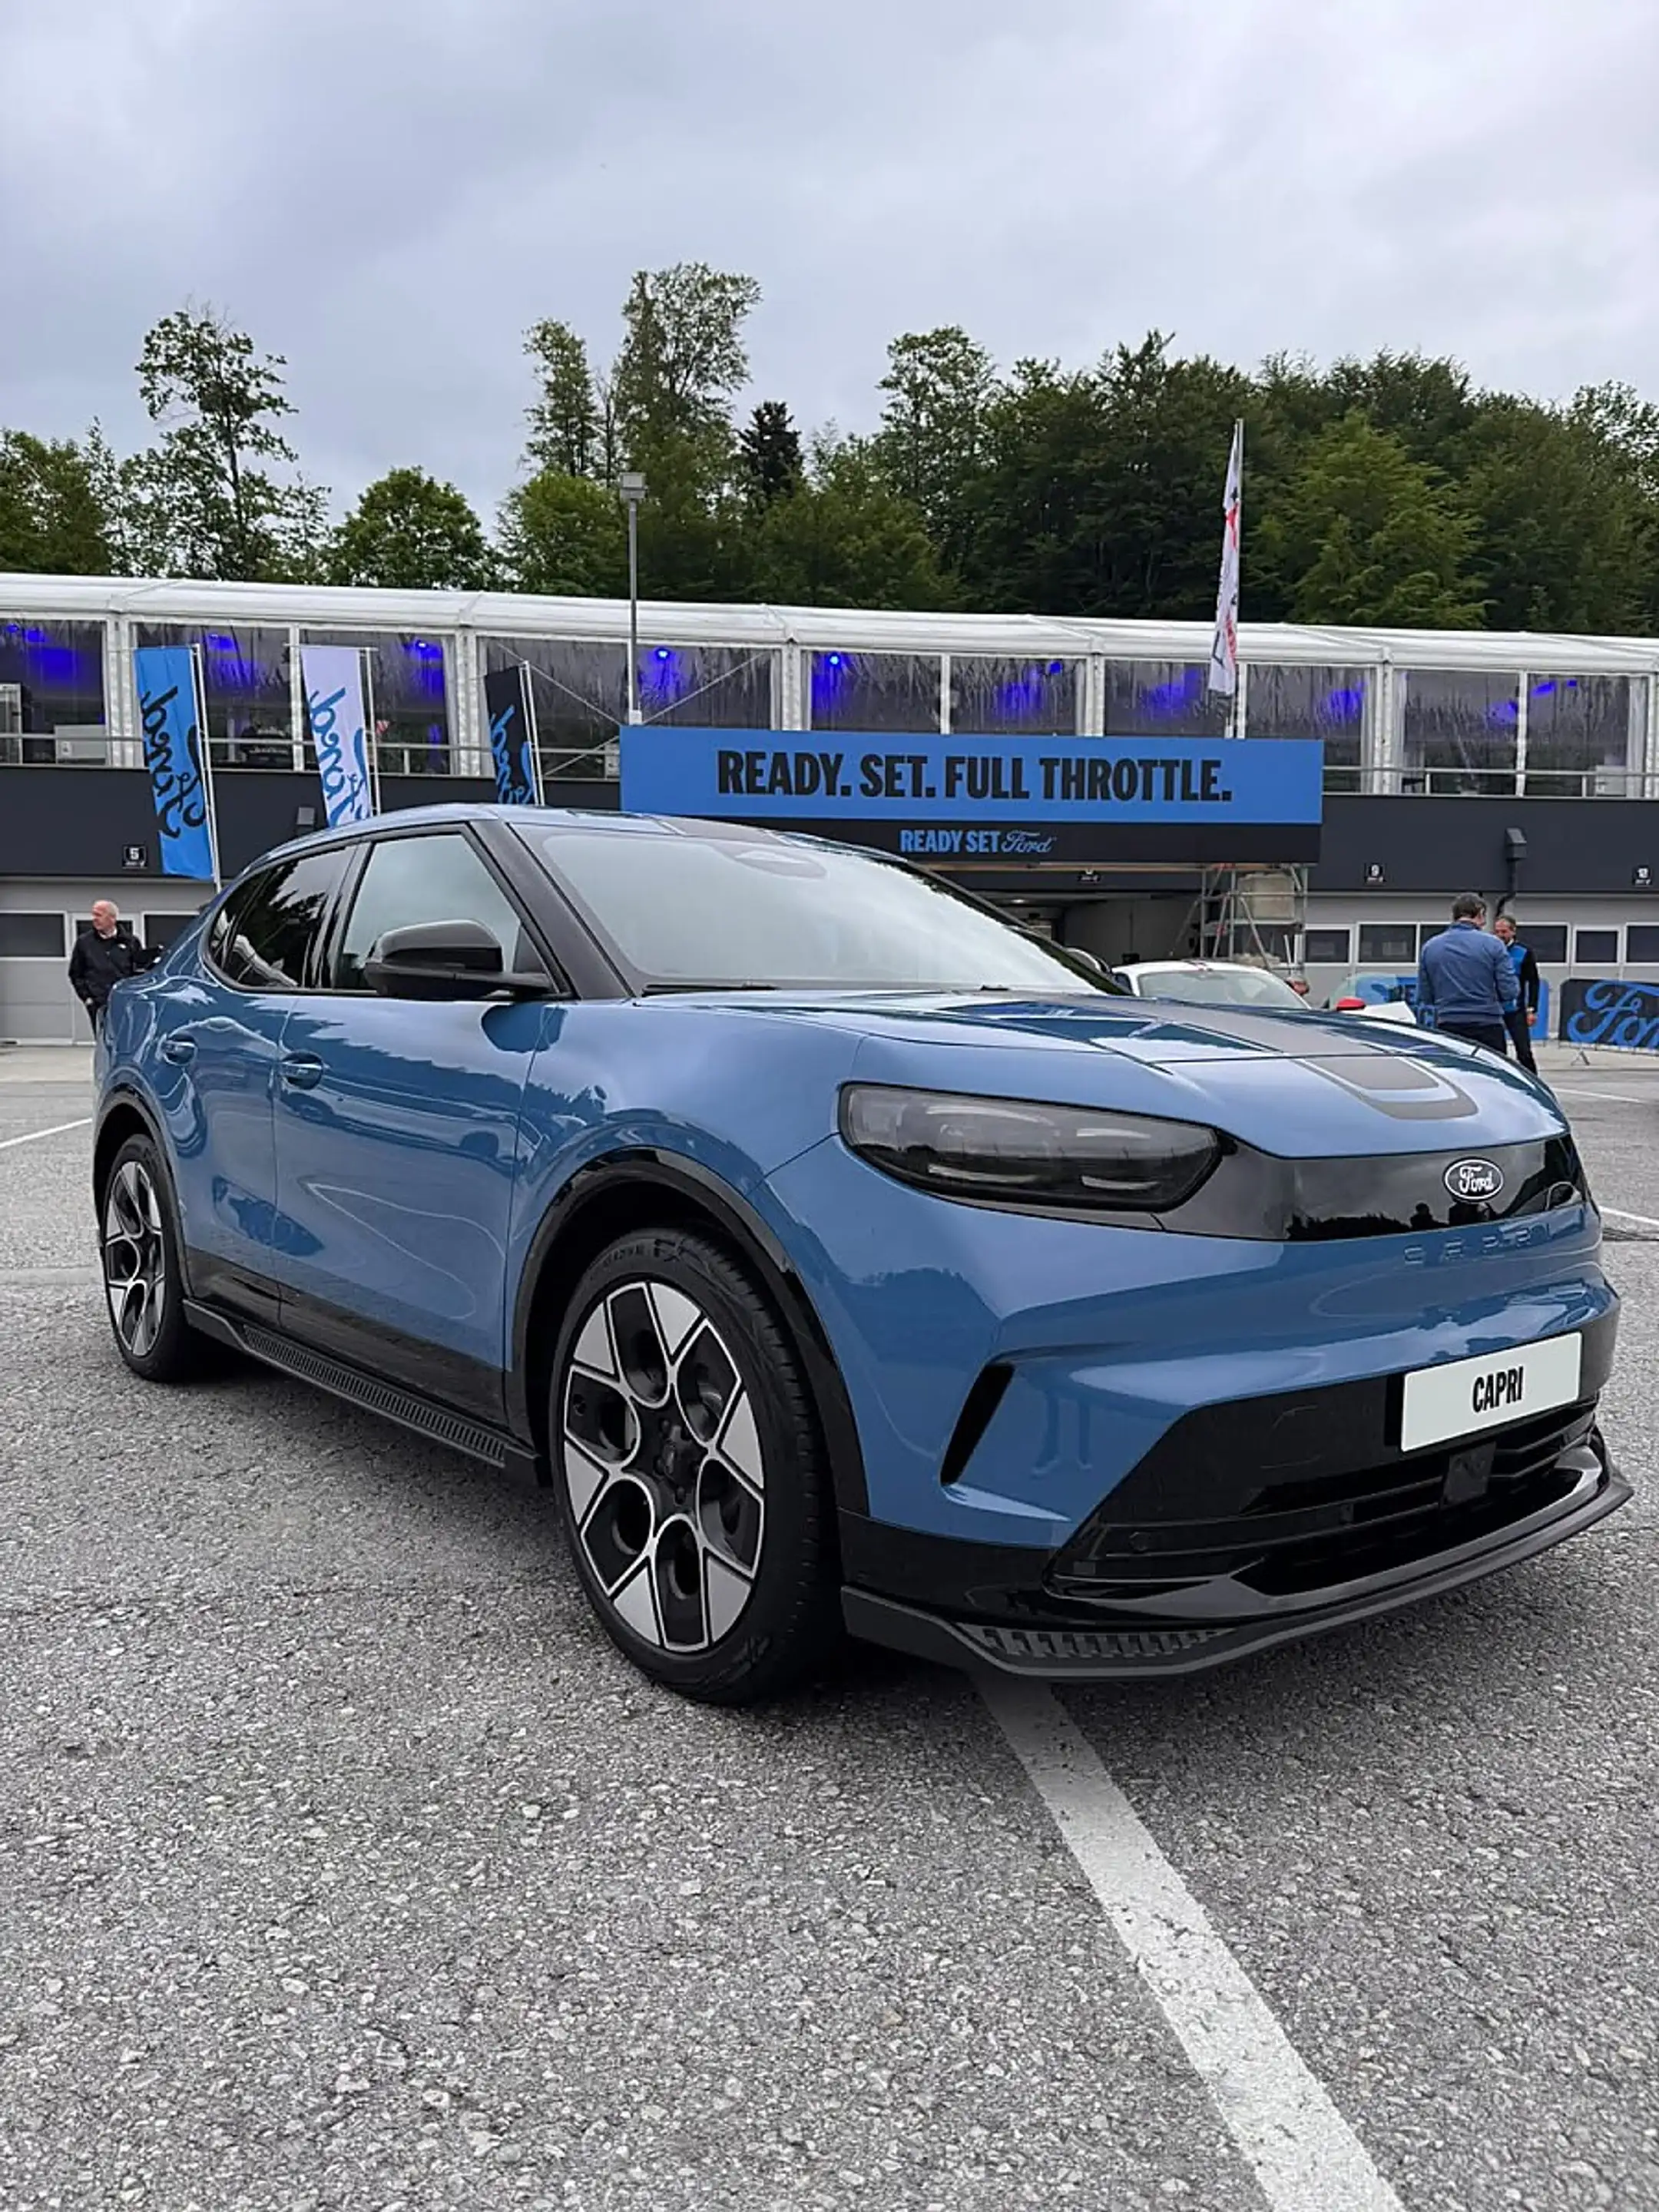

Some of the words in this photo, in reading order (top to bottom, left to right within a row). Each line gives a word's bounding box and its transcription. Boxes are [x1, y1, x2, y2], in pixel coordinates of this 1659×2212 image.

[718, 750, 852, 796] READY.
[859, 753, 936, 798] SET.
[945, 756, 1030, 800] FULL
[1039, 757, 1232, 802] THROTTLE.
[129, 847, 140, 860] 5
[900, 830, 962, 853] READY
[965, 830, 1001, 853] SET
[1001, 830, 1055, 853] Ford
[1459, 1166, 1495, 1194] Ford
[1472, 1366, 1524, 1413] CAPRI
